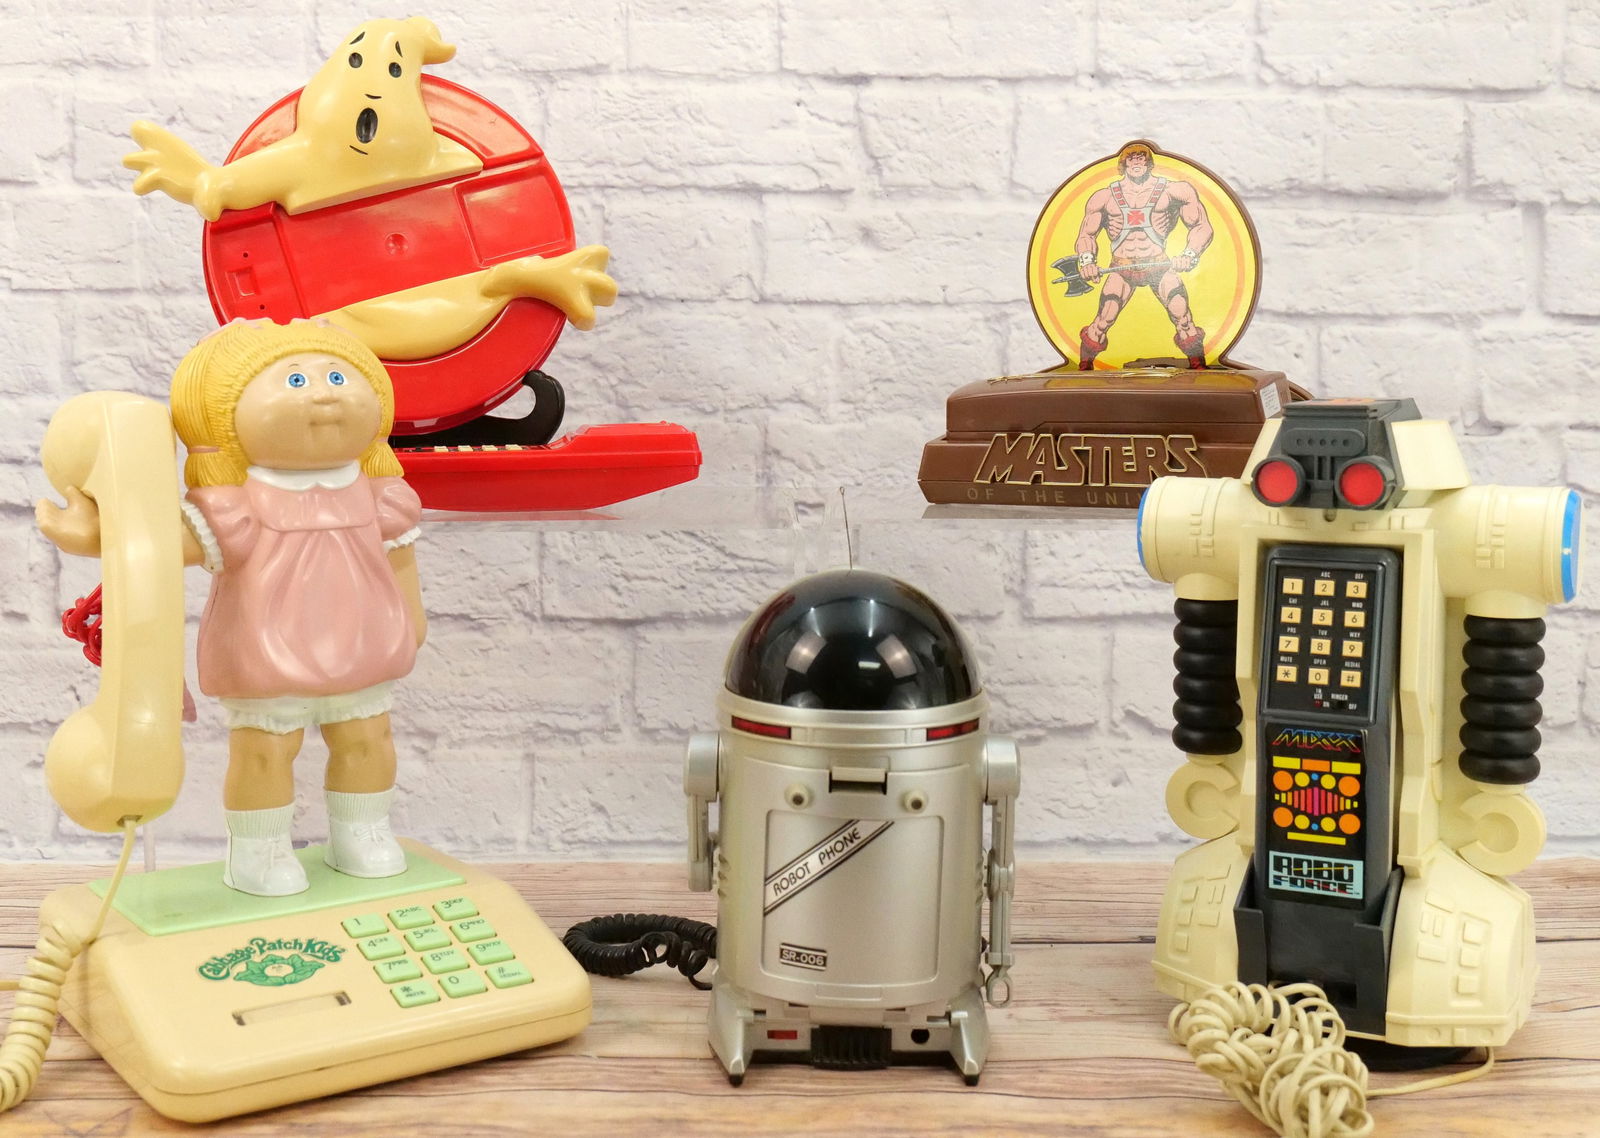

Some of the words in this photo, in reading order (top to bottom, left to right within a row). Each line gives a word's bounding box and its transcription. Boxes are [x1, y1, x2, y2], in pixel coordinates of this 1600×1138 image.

[973, 433, 1208, 487] MASTERS
[966, 487, 995, 500] OF
[1018, 489, 1066, 504] THE
[772, 861, 812, 896] ROBOT
[817, 827, 861, 865] PHONE
[1272, 854, 1354, 883] ROBO
[1272, 874, 1354, 895] FORCE
[198, 945, 256, 980] Cabbage
[250, 937, 303, 955] Patch
[301, 938, 345, 963] Kids
[781, 949, 824, 966] SR-006
